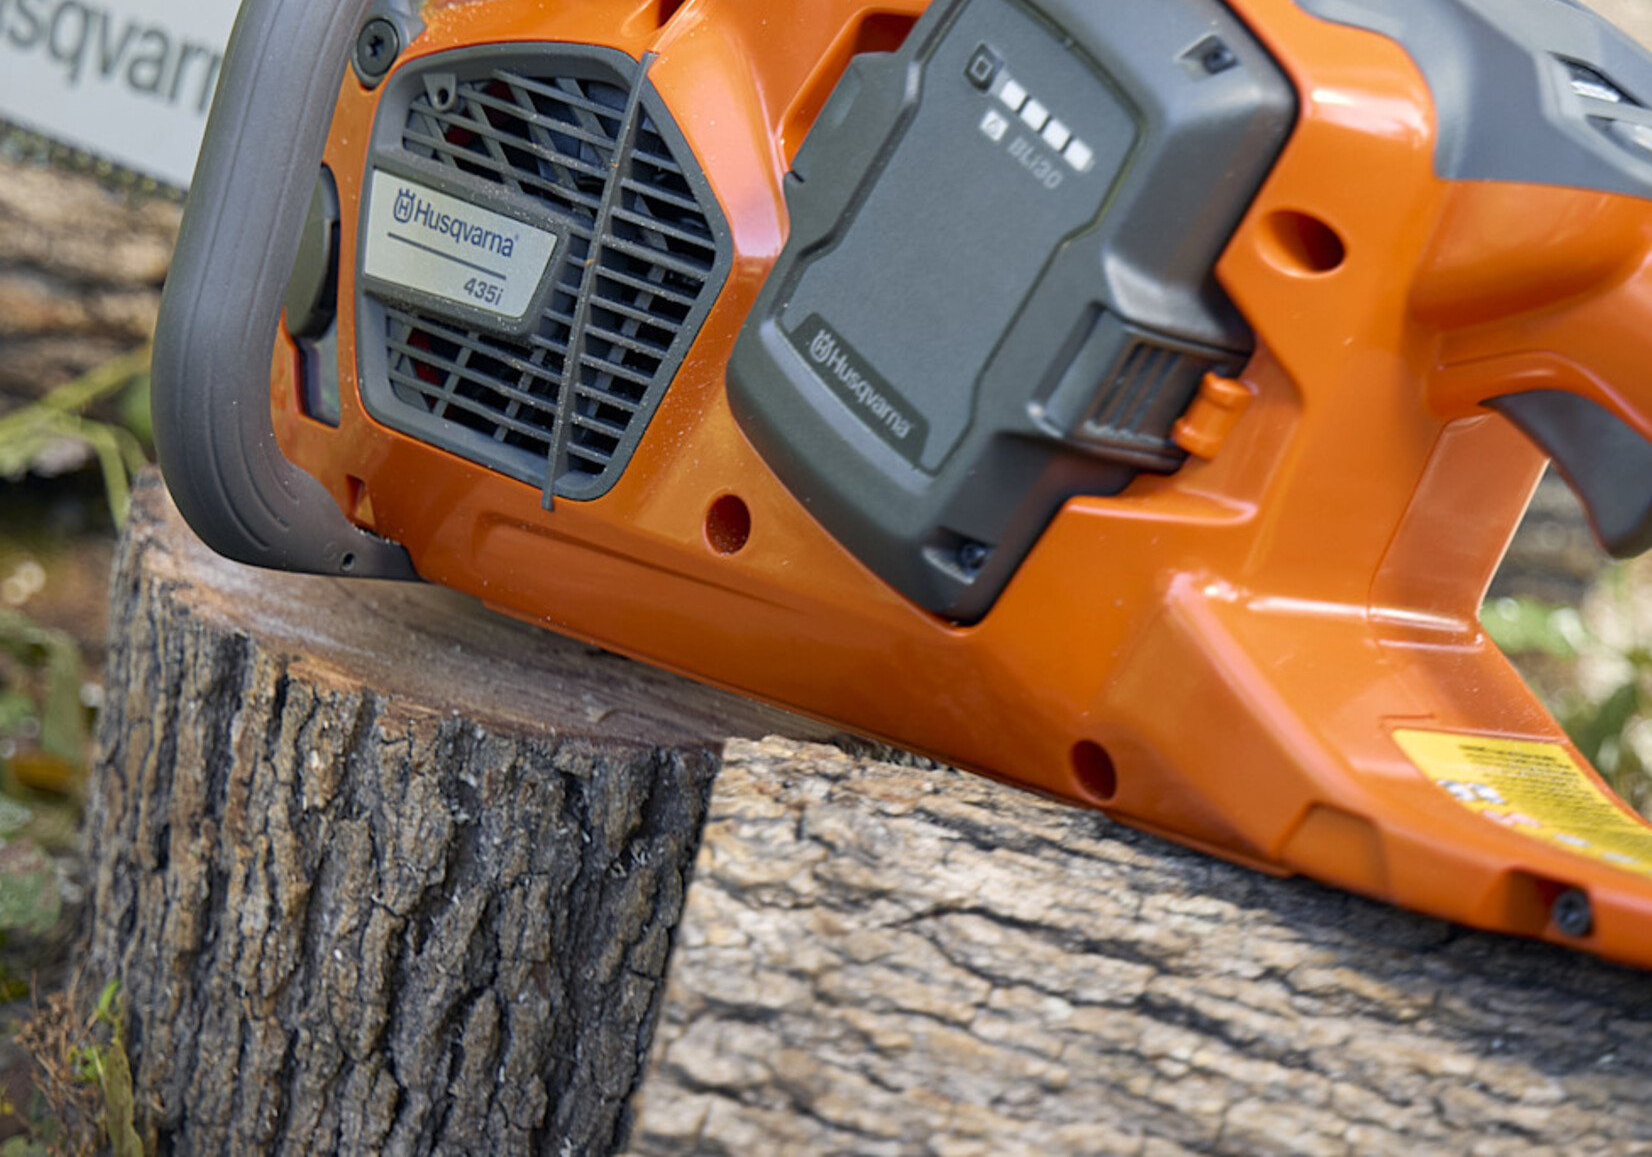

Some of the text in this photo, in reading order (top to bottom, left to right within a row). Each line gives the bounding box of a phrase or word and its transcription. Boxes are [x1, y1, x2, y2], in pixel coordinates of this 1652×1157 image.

[413, 198, 514, 258] Husqvarna
[463, 277, 504, 306] 435i
[825, 347, 912, 439] Husqvarna
